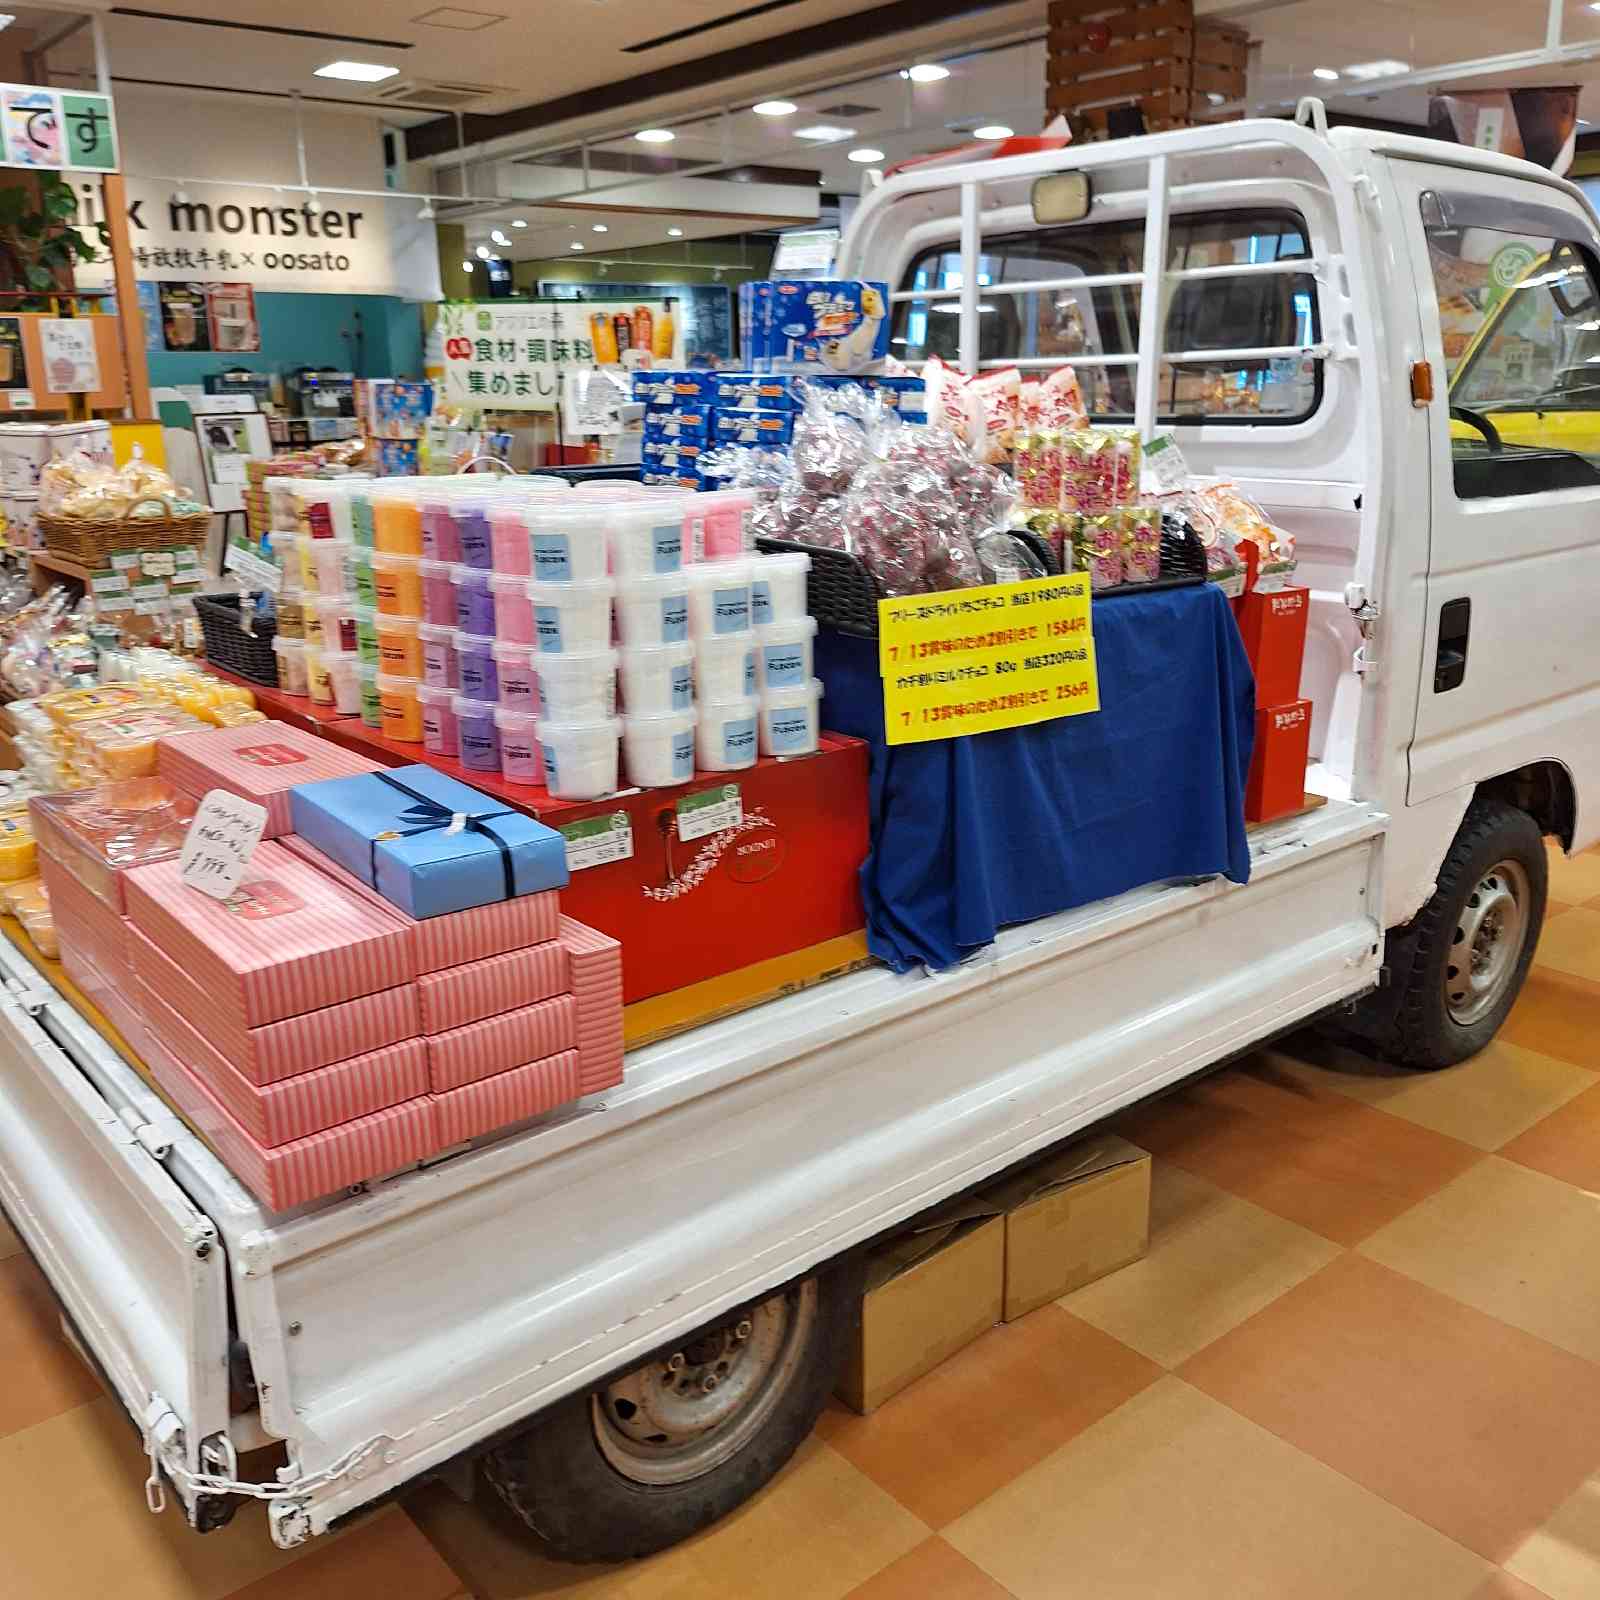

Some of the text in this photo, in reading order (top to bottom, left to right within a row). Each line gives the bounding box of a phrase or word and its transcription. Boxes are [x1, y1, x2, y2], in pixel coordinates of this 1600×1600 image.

[169, 201, 363, 239] monster
[263, 251, 350, 271] oosato
[995, 660, 1017, 675] 80g
